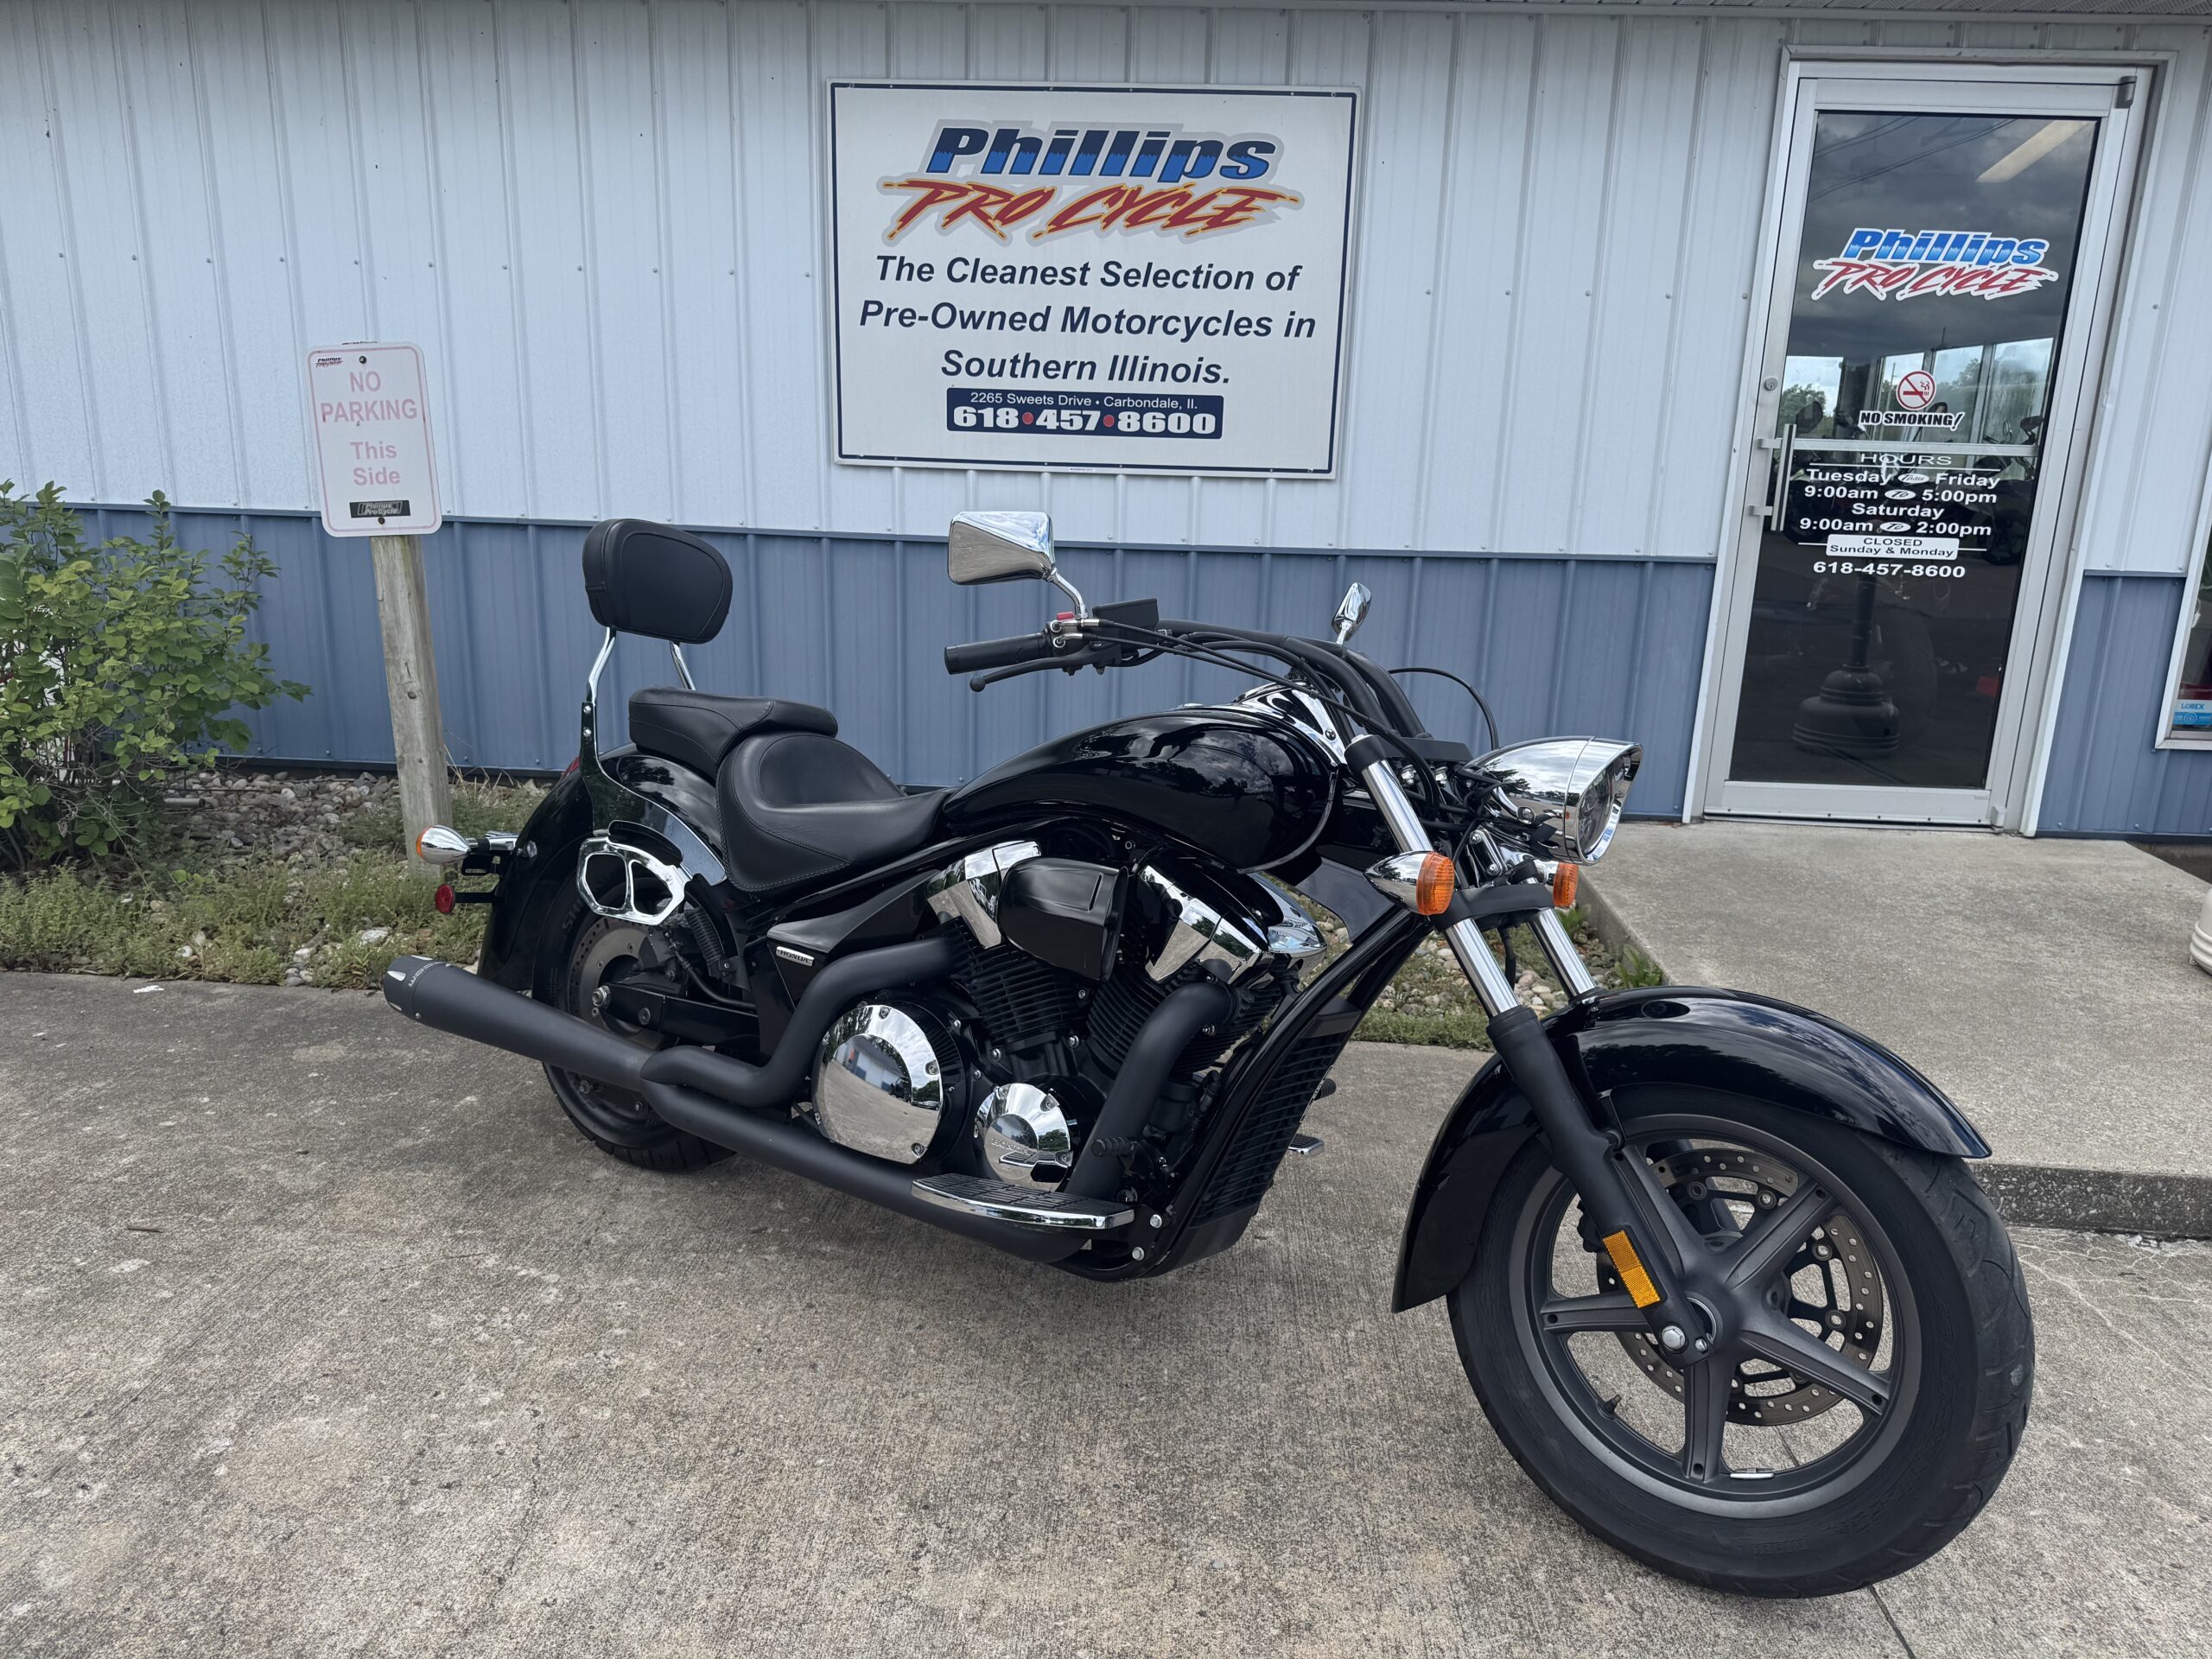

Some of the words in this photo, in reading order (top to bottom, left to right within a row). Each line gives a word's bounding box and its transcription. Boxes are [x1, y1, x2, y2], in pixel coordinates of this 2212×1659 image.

[925, 127, 1276, 183] Phillips
[881, 178, 1057, 240] PRO
[1033, 181, 1300, 239] CYCLE
[1841, 229, 2049, 267] Phillips
[877, 255, 935, 282] The
[946, 257, 1091, 287] Cleanest
[1100, 260, 1255, 290] Selection
[1265, 264, 1304, 291] of
[1813, 260, 1918, 299] PRO
[1897, 264, 2058, 300] CYCLE
[860, 300, 1052, 333] Pre-Owned
[1060, 306, 1274, 343] Motorcycles
[1283, 310, 1316, 338] in
[941, 349, 1097, 381] Southern
[1108, 354, 1230, 384] Illinois.
[349, 371, 381, 392] NO
[321, 397, 417, 423] PARKING
[970, 391, 1003, 404] 2265
[1007, 392, 1054, 406] Sweets
[1058, 394, 1092, 407] Drive
[1103, 396, 1182, 410] Carbondale,
[1860, 411, 1882, 425] NO
[1883, 412, 1964, 429] SMOKING!
[350, 441, 397, 461] This
[1860, 453, 1952, 466] HOURS
[353, 467, 401, 486] Side
[1806, 468, 1891, 486] Tuesday
[1936, 473, 2000, 490] Friday
[1804, 485, 1878, 499] 9:00am
[1922, 489, 1997, 505] 5:00pm
[1851, 503, 1945, 520] Saturday
[1799, 518, 1873, 531] 9:00am
[1916, 521, 1992, 537] 2:00pm
[1830, 545, 1881, 556] Sunday
[1885, 546, 1895, 555] &
[1900, 547, 1955, 557] Monday
[1863, 537, 1923, 547] CLOSED
[1813, 562, 1966, 578] 618-457-8600
[779, 950, 810, 963] HONDA
